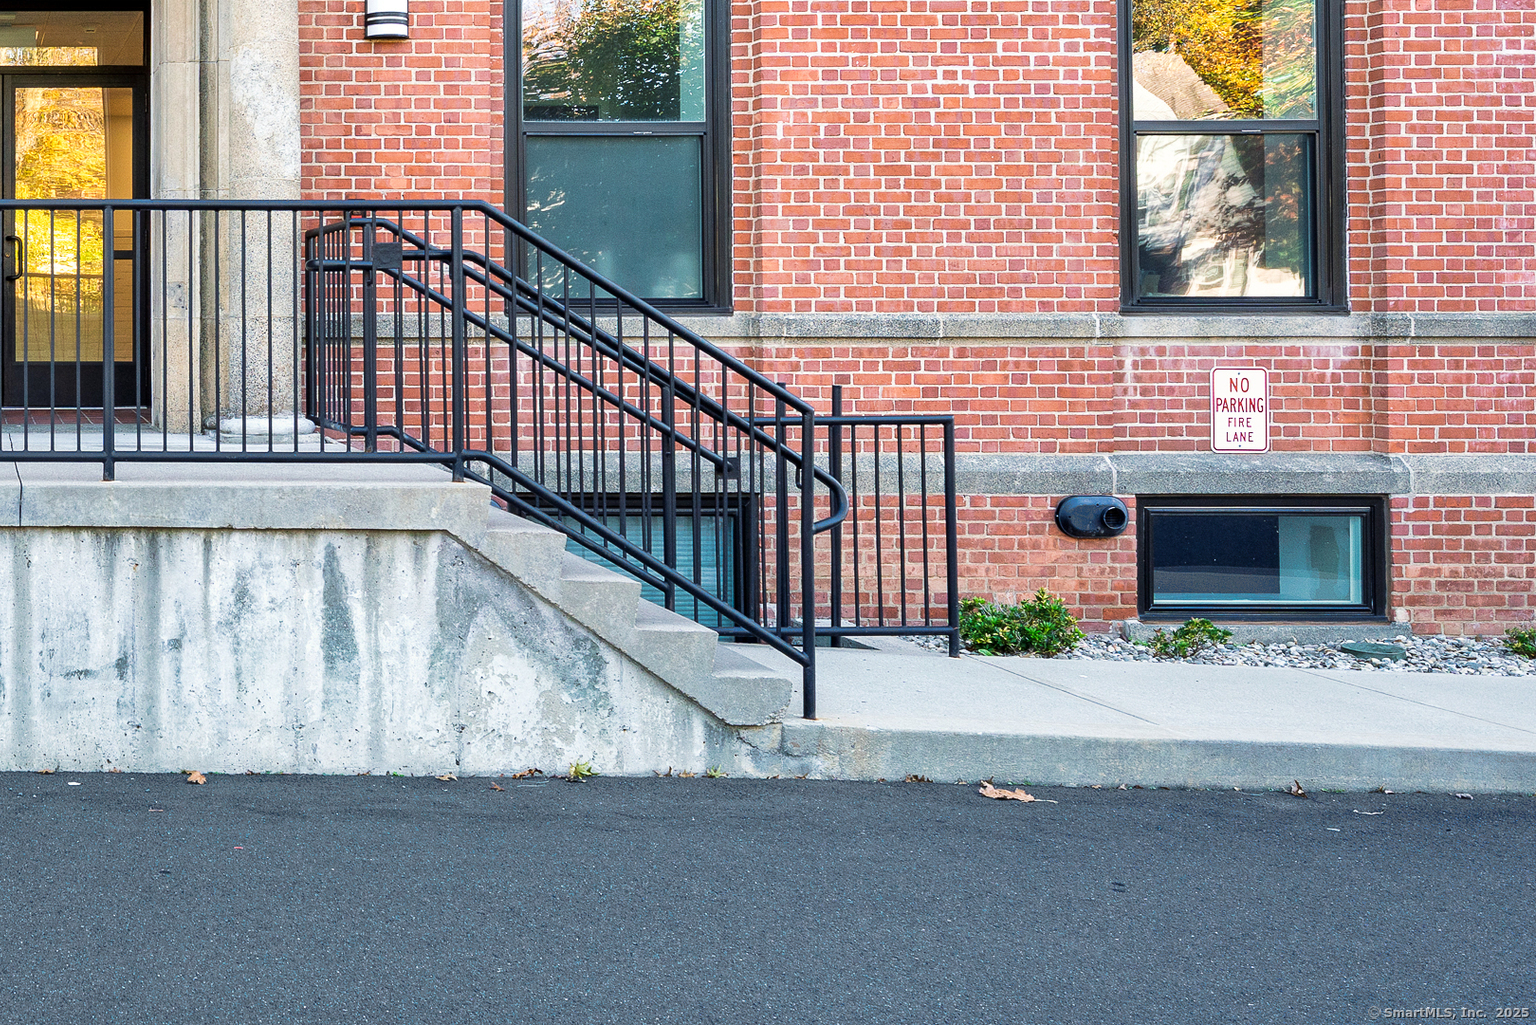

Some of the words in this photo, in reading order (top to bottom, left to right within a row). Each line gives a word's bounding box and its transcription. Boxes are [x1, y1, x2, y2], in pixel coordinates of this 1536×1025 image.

[1229, 377, 1250, 393] NO
[1215, 397, 1264, 413] PARKING
[1227, 417, 1252, 428] FIRE
[1226, 431, 1254, 443] LANE
